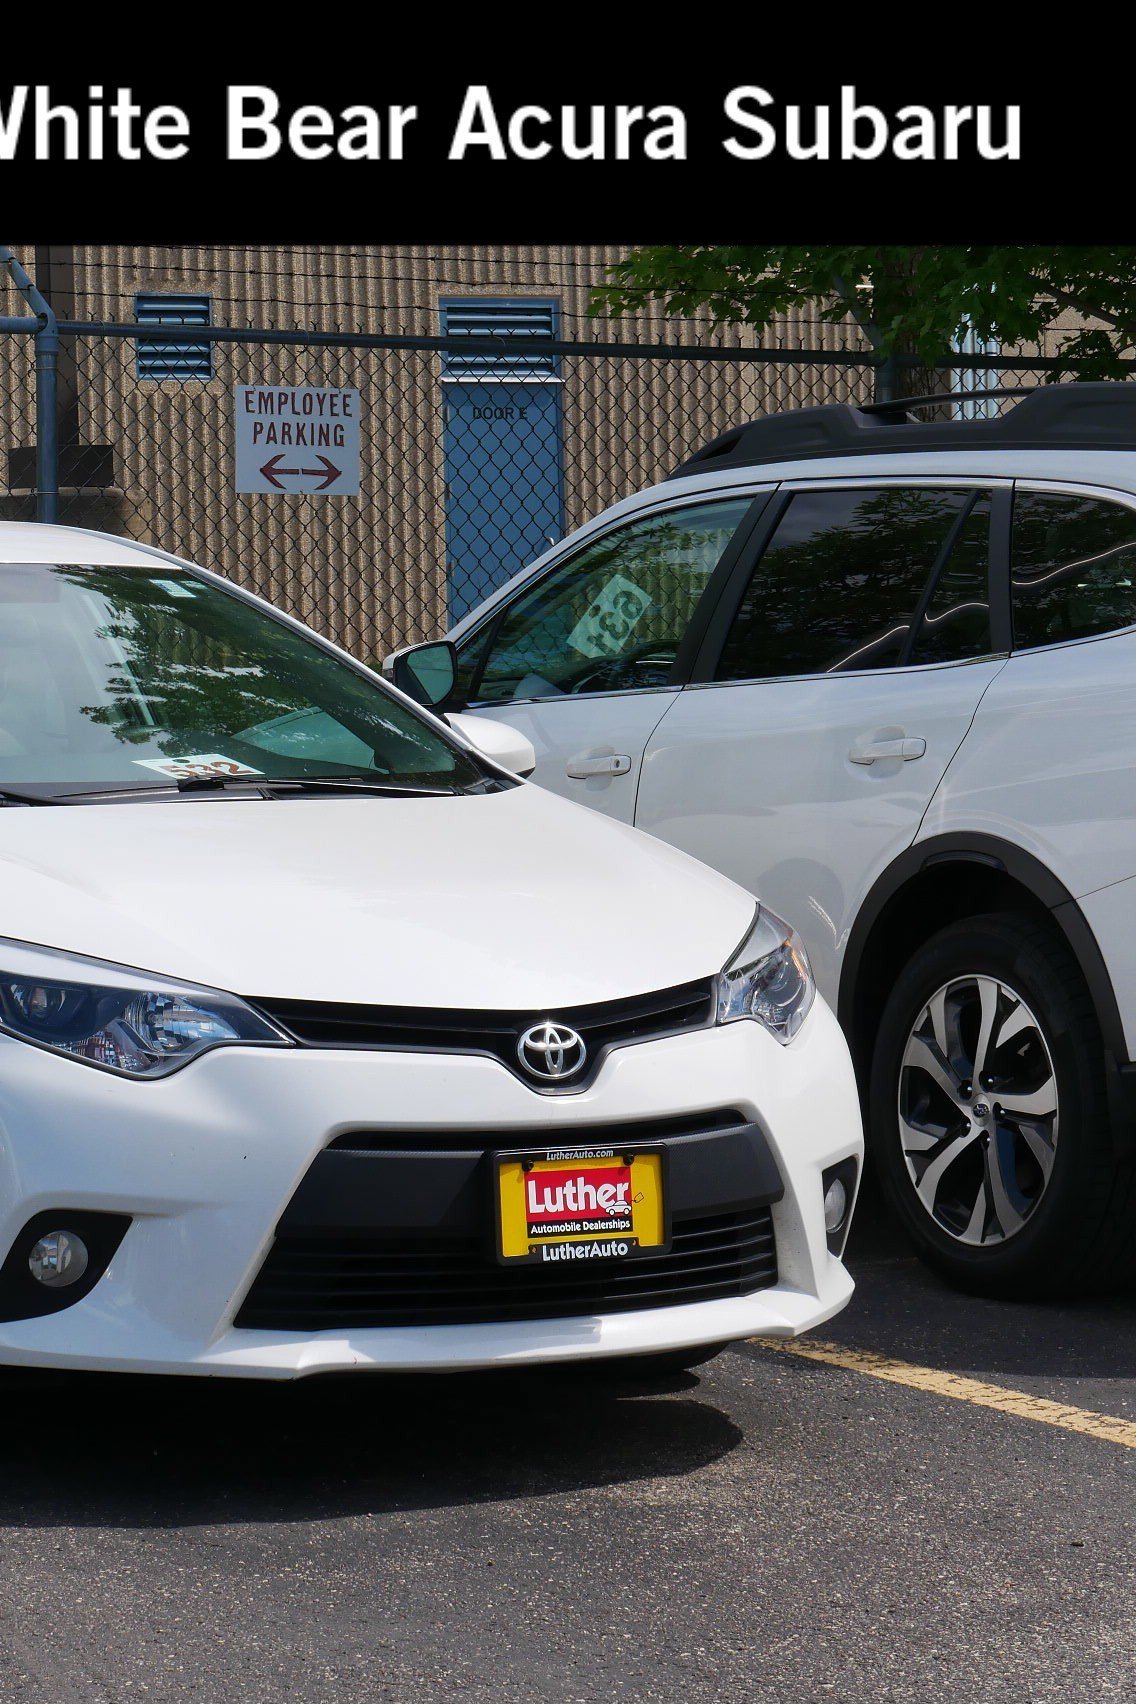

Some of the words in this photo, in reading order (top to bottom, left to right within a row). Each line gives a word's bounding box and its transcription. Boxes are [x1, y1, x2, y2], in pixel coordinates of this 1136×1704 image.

[244, 389, 353, 418] EMPLOYEE
[472, 406, 515, 421] DOOR
[252, 421, 345, 448] PARKING
[546, 1150, 614, 1161] LutherAuto.com
[527, 1176, 630, 1214] Luther
[530, 1221, 582, 1235] Automobile
[583, 1219, 631, 1232] Dealerships
[542, 1240, 629, 1262] LutherAuto
